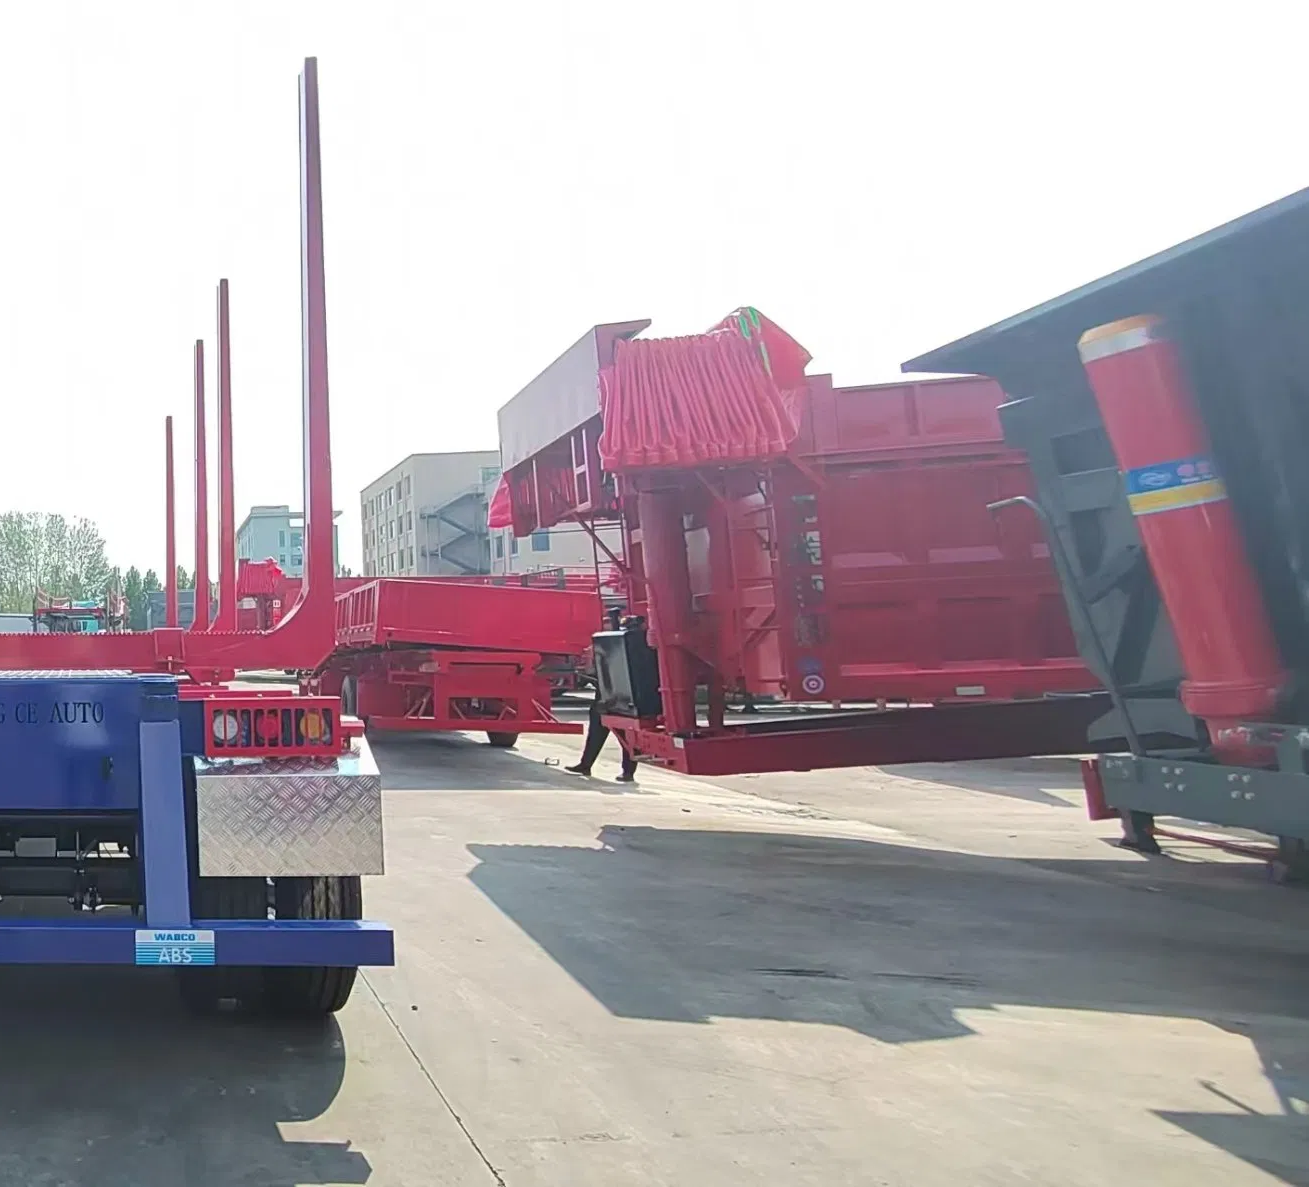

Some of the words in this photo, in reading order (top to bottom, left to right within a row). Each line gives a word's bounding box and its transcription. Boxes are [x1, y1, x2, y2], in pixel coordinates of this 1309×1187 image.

[15, 702, 38, 724] CE
[50, 701, 104, 723] AUTO
[154, 933, 196, 941] WABCO
[158, 948, 193, 963] ABS
